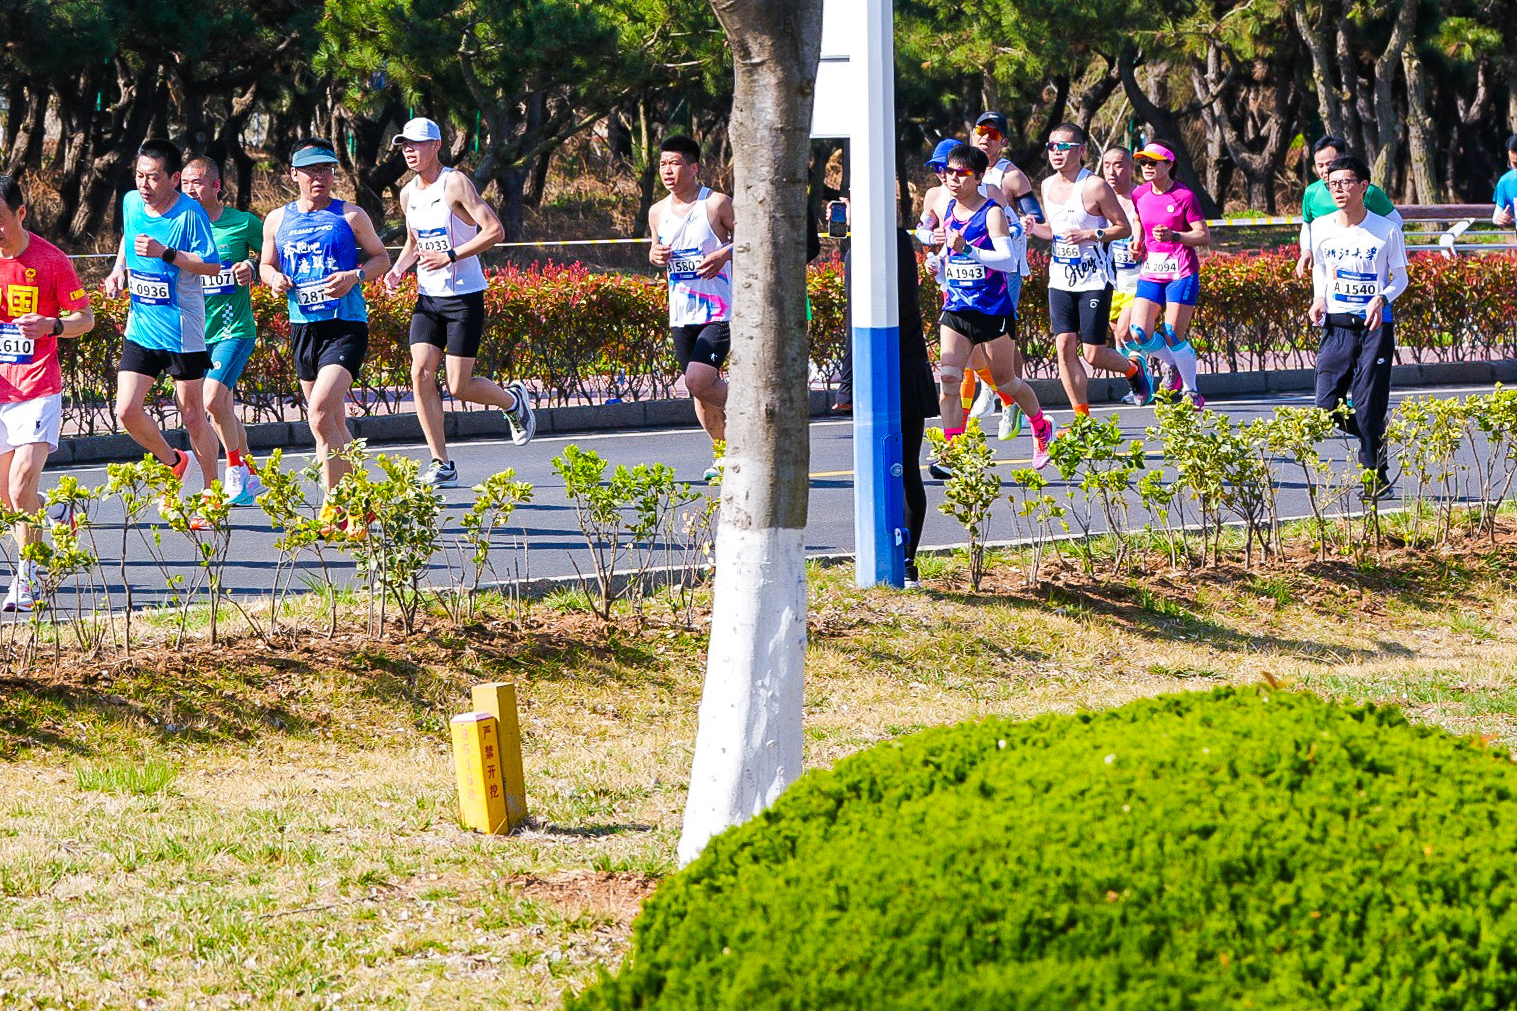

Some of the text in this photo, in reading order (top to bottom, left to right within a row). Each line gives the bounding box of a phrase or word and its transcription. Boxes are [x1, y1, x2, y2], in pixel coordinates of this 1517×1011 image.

[946, 267, 983, 279] A 1943
[1153, 262, 1177, 272] 2094
[136, 283, 168, 298] 0936
[1333, 281, 1376, 295] A 1540
[482, 725, 499, 799] 严禁开挖
